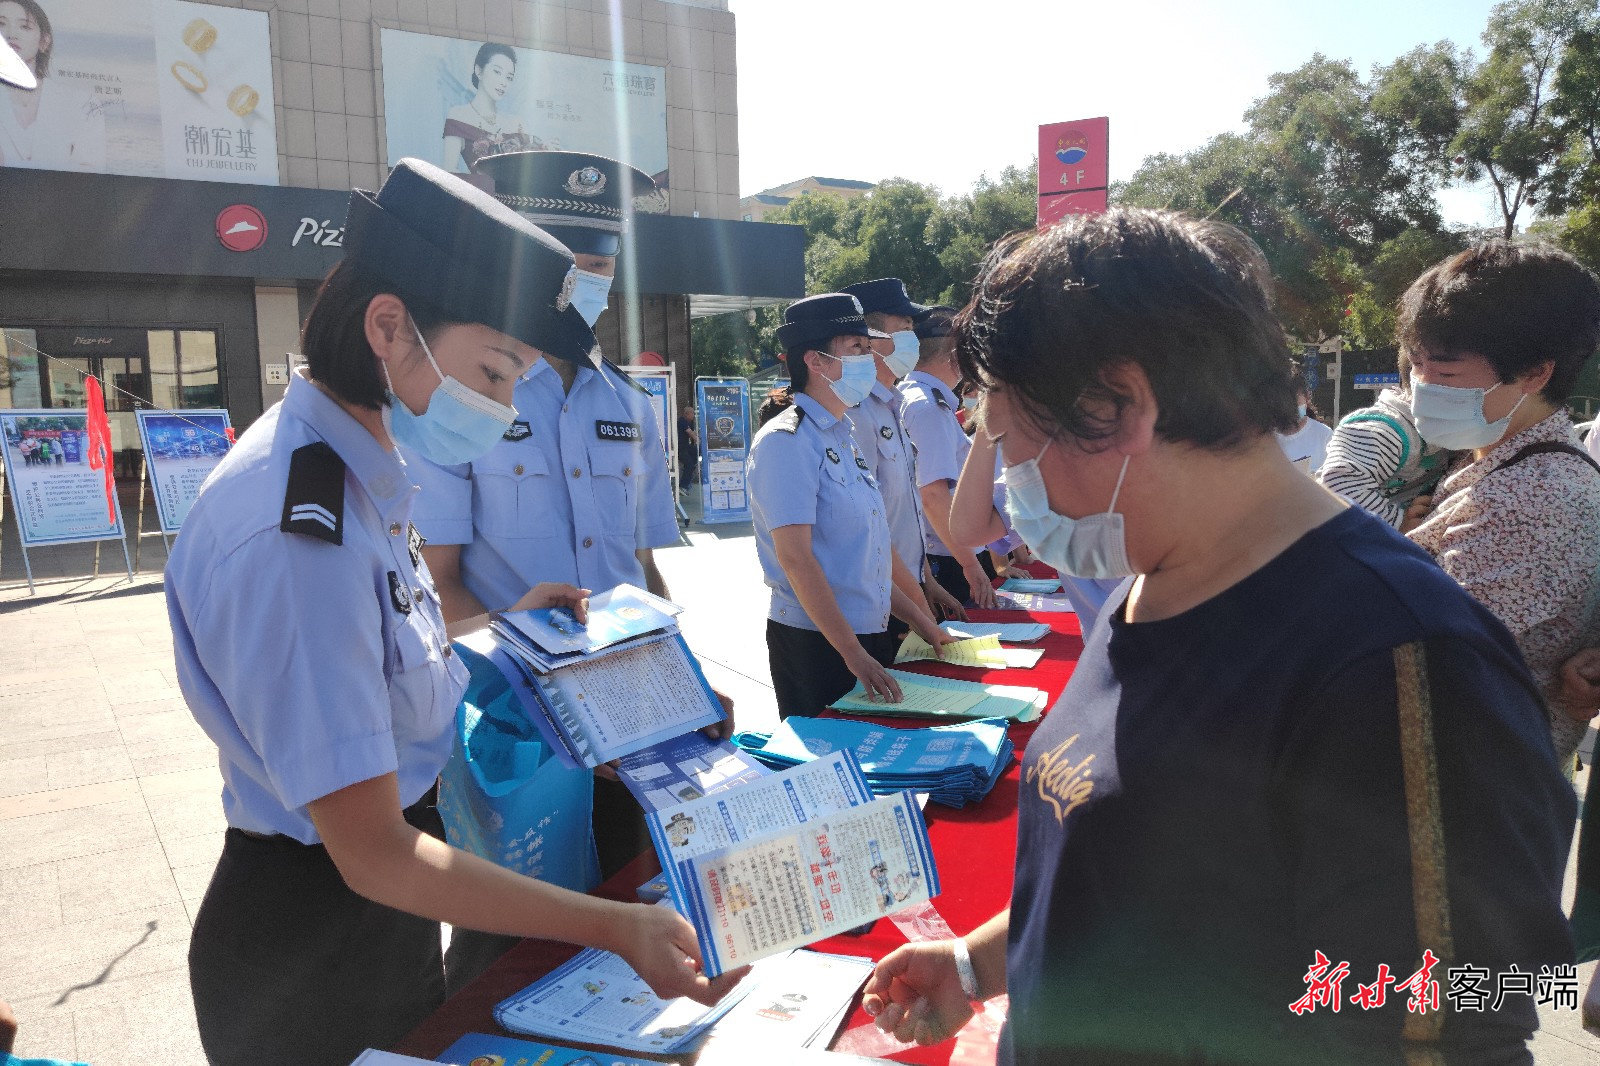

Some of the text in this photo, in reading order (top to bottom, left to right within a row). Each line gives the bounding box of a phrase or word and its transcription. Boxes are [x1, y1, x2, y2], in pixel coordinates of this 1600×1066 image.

[184, 125, 257, 160] 潮宏基
[600, 424, 639, 438] 061398
